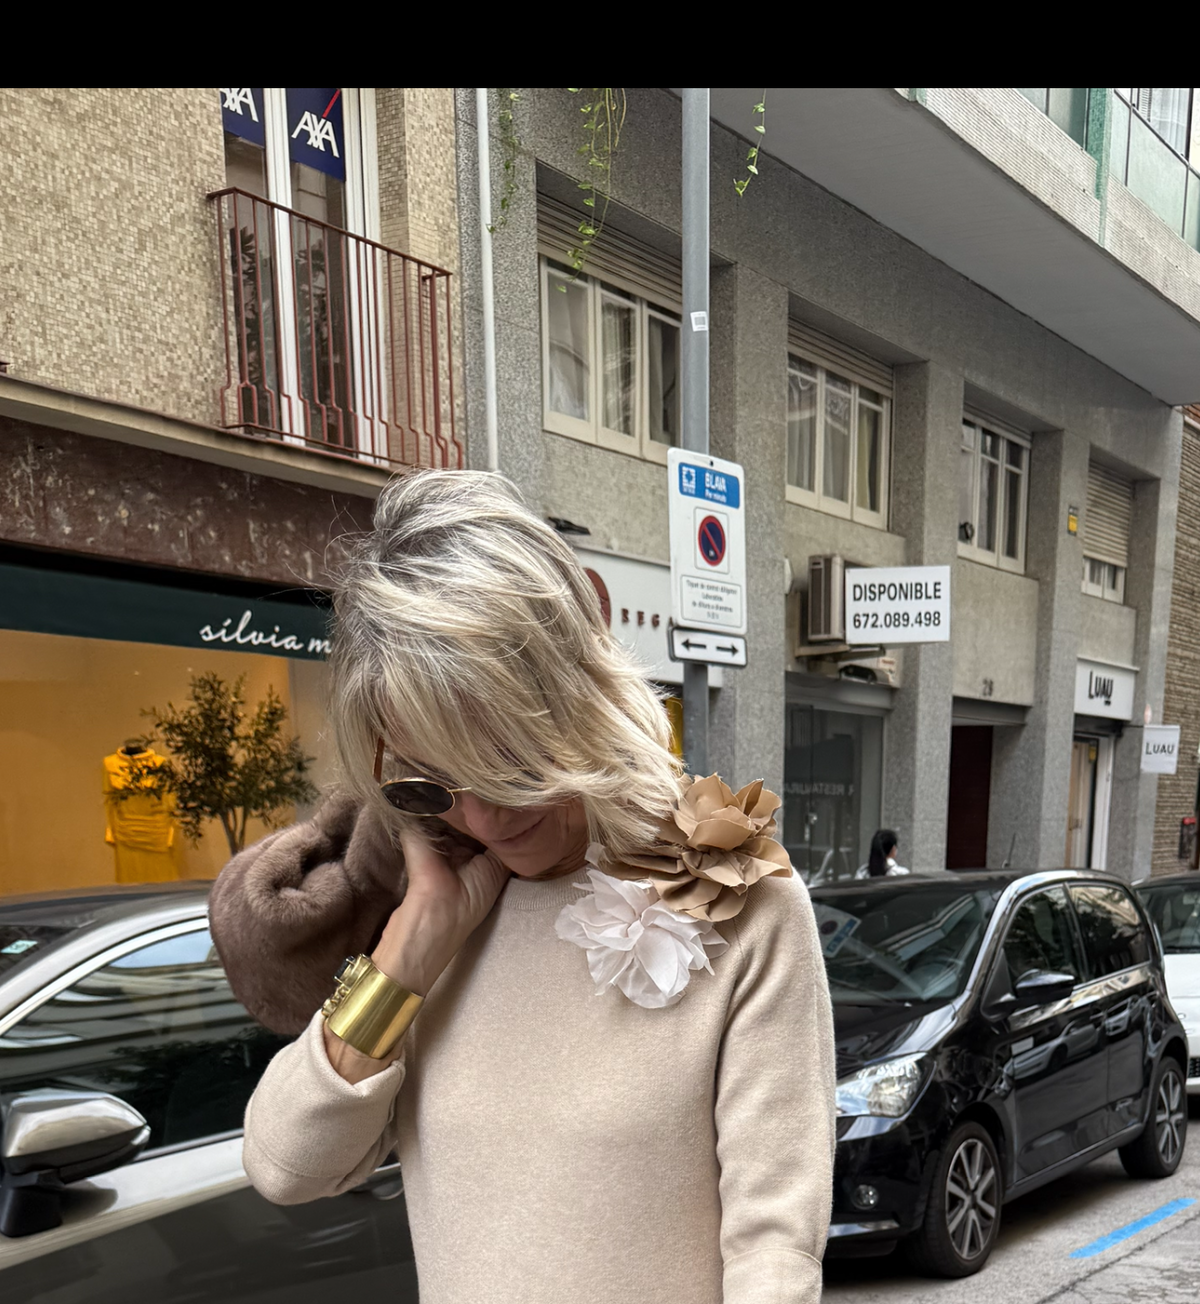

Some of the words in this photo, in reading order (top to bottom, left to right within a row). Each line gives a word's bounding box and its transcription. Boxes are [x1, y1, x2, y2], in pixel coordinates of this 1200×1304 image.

[291, 111, 340, 158] AXA
[852, 581, 942, 602] DISPONIBLE
[852, 610, 941, 630] 672.089.498
